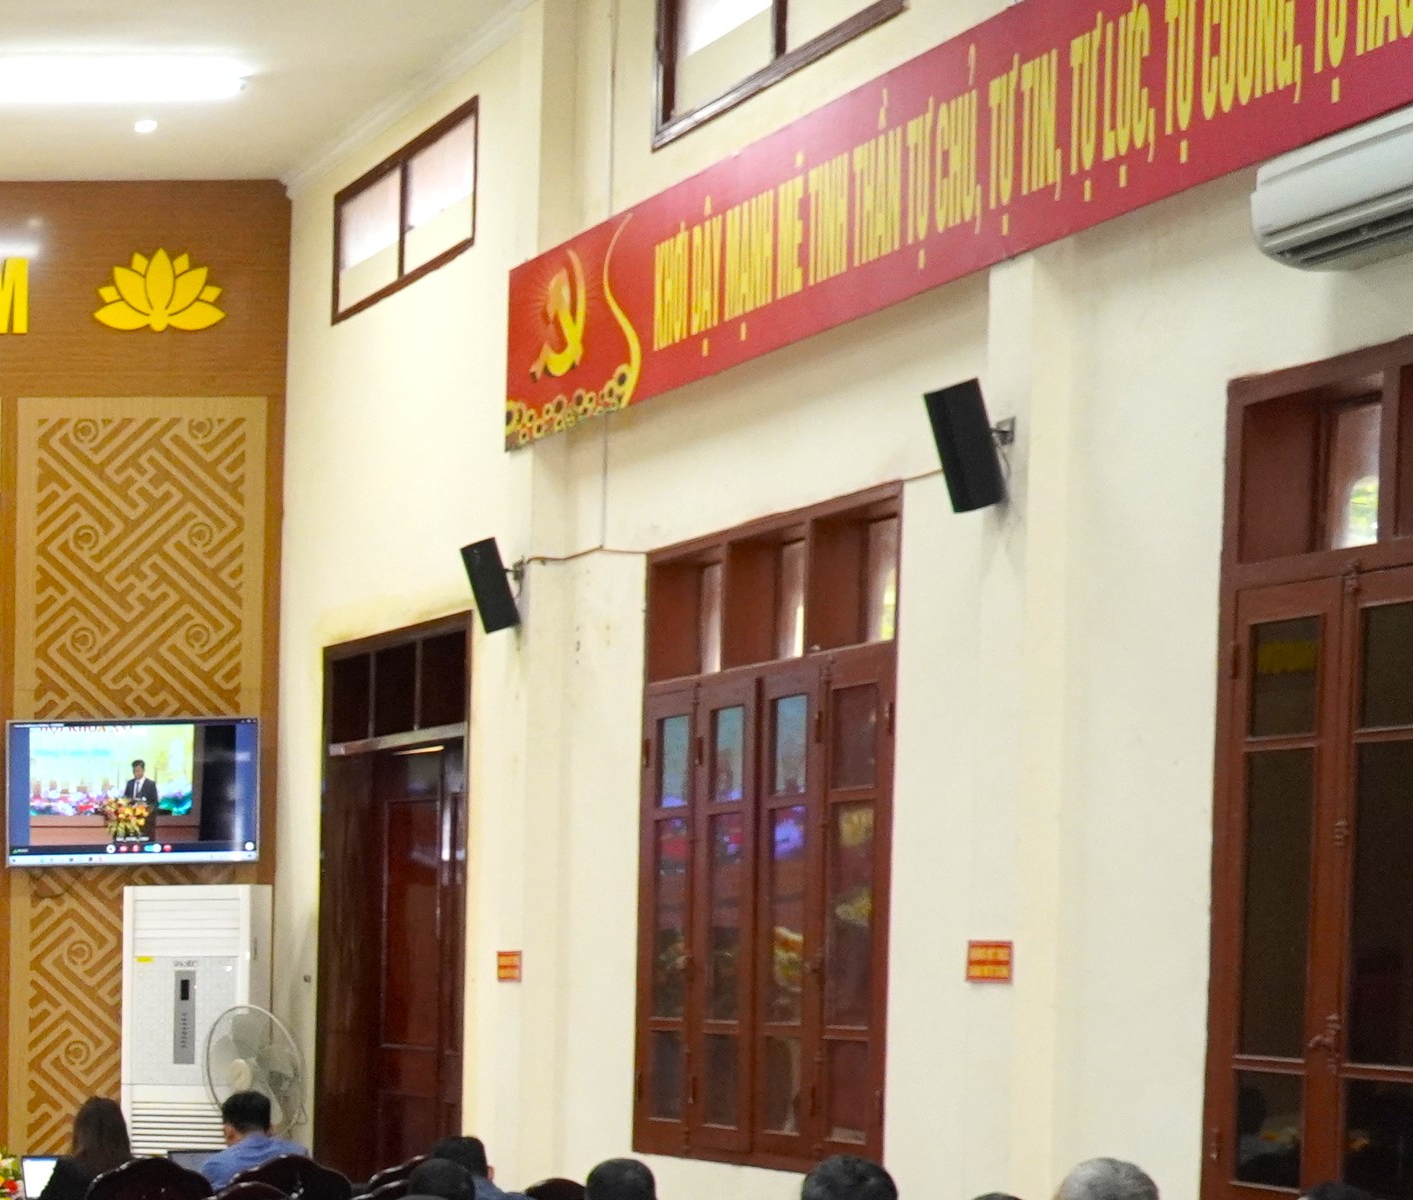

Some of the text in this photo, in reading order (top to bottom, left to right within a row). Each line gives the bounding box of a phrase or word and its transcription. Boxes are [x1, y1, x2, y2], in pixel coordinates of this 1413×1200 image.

[808, 152, 849, 287] TINH
[907, 95, 933, 269] TỰ
[936, 42, 982, 235] CHỦ,
[989, 52, 1019, 236] TỰ
[1021, 48, 1062, 200] TIN,
[1070, 11, 1102, 202] TỰ
[1102, 0, 1155, 187] LỰC,
